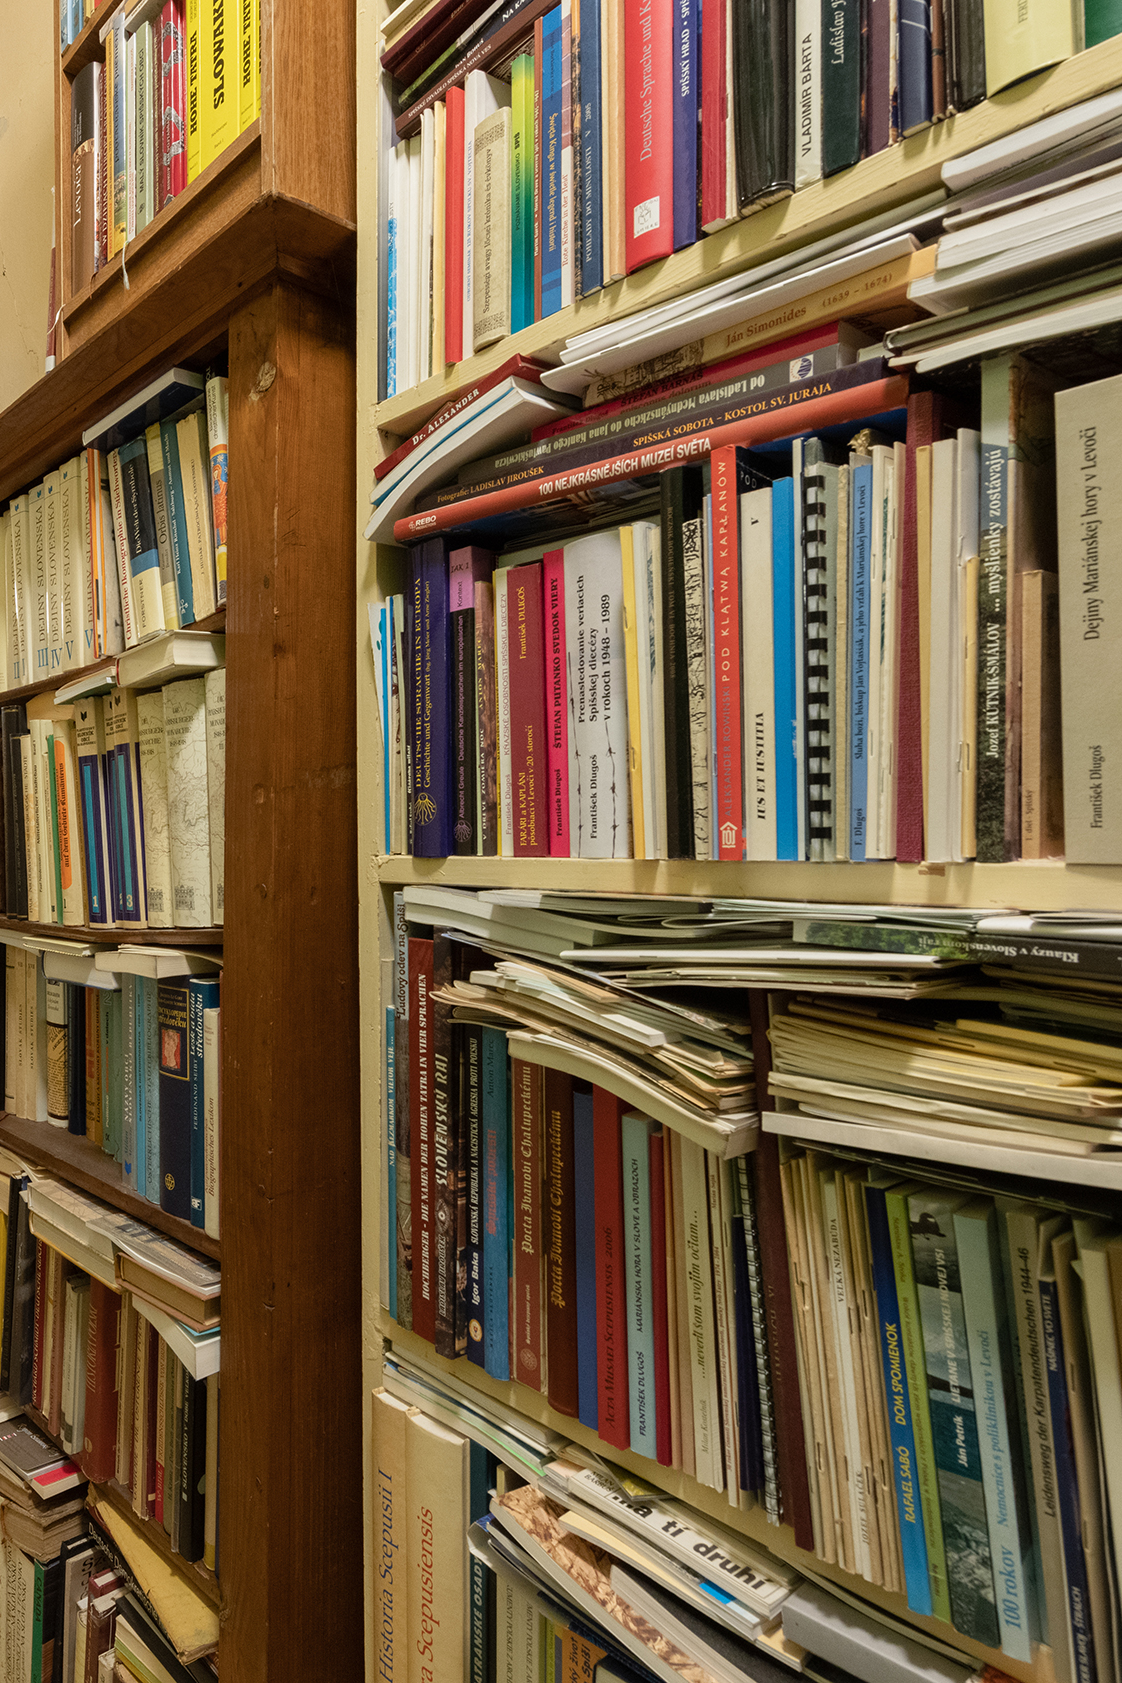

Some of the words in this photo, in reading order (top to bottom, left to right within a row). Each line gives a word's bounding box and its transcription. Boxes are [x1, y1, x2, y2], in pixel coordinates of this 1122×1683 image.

[639, 16, 652, 42] und
[680, 28, 689, 57] HRAD
[188, 29, 198, 85] TATRA
[639, 43, 654, 98] Sprache
[800, 32, 811, 84] BÁRTA
[679, 59, 689, 96] SPIŠSKÝ
[188, 86, 198, 136] HOHE
[639, 99, 652, 161] Deutsche
[800, 86, 811, 156] VLADIMÍR
[723, 329, 745, 346] Ján
[744, 304, 807, 337] Simonides
[821, 290, 851, 309] (1639
[862, 272, 893, 292] 1674)
[410, 431, 426, 445] Dr.
[424, 388, 481, 433] ALEXANDER
[436, 487, 470, 504] Fotografie:
[468, 477, 506, 494] LADISLAV
[504, 464, 545, 483] JIROUŠEK
[631, 428, 671, 447] SPIŠSKÁ
[672, 416, 714, 435] SOBOTA
[723, 400, 768, 421] KOSTOL
[769, 395, 786, 407] SV.
[787, 382, 832, 403] JURAJA
[1079, 425, 1098, 469] Levoči
[109, 449, 121, 508] Stichworten
[127, 464, 138, 502] Symbole
[537, 481, 554, 495] 100
[552, 454, 640, 494] NEJKRÁSNĚJŠÍCH
[638, 446, 675, 469] MUZEÍ
[674, 435, 712, 459] SVĚTA
[985, 449, 1004, 517] zostávajú
[1084, 473, 1096, 481] v
[115, 510, 122, 518] in
[130, 502, 138, 518] der
[152, 479, 165, 513] latinus
[1080, 484, 1101, 516] hory
[35, 505, 43, 586] SLOVENSKA
[131, 517, 140, 538] Welt
[134, 537, 142, 553] Die
[155, 515, 168, 544] Orbis
[116, 520, 130, 584] Ikonographie
[986, 521, 1004, 593] myšlienky
[1081, 519, 1102, 592] Mariánskej
[138, 578, 146, 627] FORSTNER
[516, 586, 525, 620] DLUGOŠ
[550, 577, 559, 608] VIERY
[600, 594, 610, 622] 1989
[37, 592, 45, 641] DEJINY
[122, 587, 133, 640] Christliche
[551, 611, 560, 653] SVEDOK
[1082, 597, 1103, 640] Dejiny
[38, 648, 49, 668] III
[51, 648, 62, 670] IV
[415, 635, 421, 648] IN
[518, 622, 526, 658] František
[587, 627, 598, 670] diecézy
[600, 636, 610, 665] 1948
[552, 657, 561, 706] PUTANKO
[577, 629, 585, 722] Prenasledovanie
[601, 670, 610, 710] rokoch
[984, 622, 999, 723] KÚTNIK-ŠMÁLOV
[588, 673, 599, 721] Spišskej
[525, 725, 533, 751] storočí
[552, 709, 562, 748] ŠTEFAN
[755, 711, 765, 772] IUSTITIA
[985, 727, 998, 758] Jozef
[589, 754, 599, 788] Dlugoš
[1088, 744, 1105, 779] Dlugoš
[526, 774, 534, 799] Levoči
[554, 768, 562, 795] Dlugoš
[756, 775, 765, 792] ET
[554, 797, 563, 836] František
[756, 796, 765, 819] IUS
[1088, 782, 1103, 828] František
[518, 817, 526, 845] FARÁRI
[527, 807, 537, 845] pôsobiaci
[396, 904, 407, 932] Spiši
[398, 934, 405, 946] na
[942, 938, 1017, 956] Slovenskom
[1030, 946, 1079, 963] Klauzy
[397, 950, 405, 975] odev
[396, 976, 407, 1018] Ľudový
[417, 973, 426, 1027] SPRACHEN
[194, 993, 204, 1057] středověku
[418, 1029, 427, 1052] VIER
[419, 1056, 427, 1067] IN
[434, 1053, 448, 1083] RAJ
[419, 1070, 427, 1101] TATRA
[419, 1105, 428, 1140] HOHEN
[432, 1088, 449, 1184] SLOVENSKÝ
[207, 1135, 216, 1196] Biographisches
[420, 1143, 428, 1164] DER
[420, 1167, 428, 1201] NAMEN
[631, 1158, 639, 1204] OBRAZOCH
[421, 1229, 429, 1299] HOCHBERGER
[471, 1282, 480, 1304] Igor
[634, 1280, 643, 1332] MARIÁNSKA
[882, 1320, 906, 1394] SPOMIENOK
[975, 1328, 992, 1367] Levoči
[1020, 1298, 1047, 1418] Karpatendeutschen
[635, 1350, 645, 1386] DLUGOŠ
[636, 1387, 646, 1436] FRANTIŠEK
[891, 1395, 907, 1426] DOM
[981, 1379, 1003, 1453] poliklinikou
[1036, 1422, 1047, 1440] der
[378, 1466, 391, 1482] I
[895, 1445, 911, 1479] SABÓ
[1038, 1442, 1056, 1517] Leidensweg
[901, 1480, 915, 1523] RAFAEL
[990, 1462, 1010, 1527] Nemocnice
[378, 1485, 398, 1584] Scepusii
[662, 1516, 687, 1540] tí
[692, 1539, 766, 1590] druhí
[416, 1506, 439, 1662] Scepusiensis
[996, 1543, 1017, 1598] rokov
[1001, 1597, 1021, 1630] 100
[378, 1588, 393, 1682] Historia
